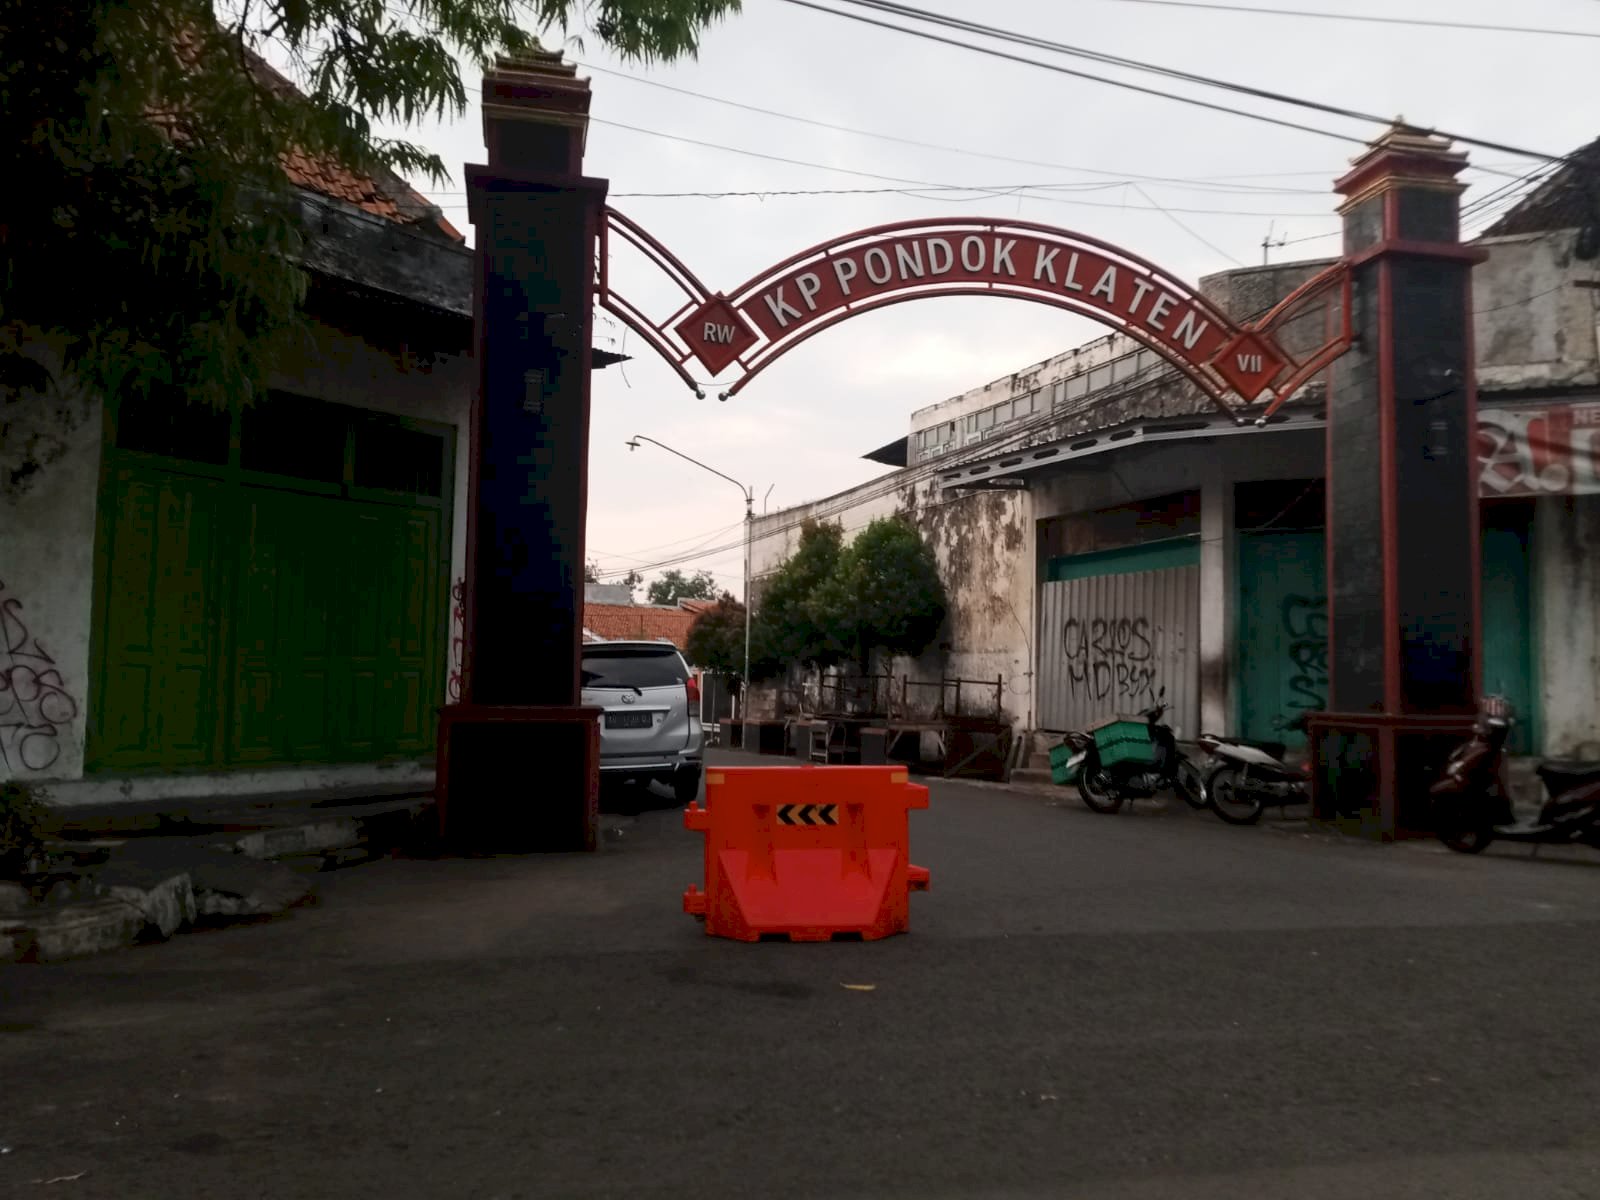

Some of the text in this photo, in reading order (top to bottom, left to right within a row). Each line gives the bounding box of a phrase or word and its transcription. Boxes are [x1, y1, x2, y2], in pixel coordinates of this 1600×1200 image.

[763, 235, 1209, 350] KP PONDOK KLATEN
[703, 321, 736, 344] RW
[1236, 354, 1262, 373] VII
